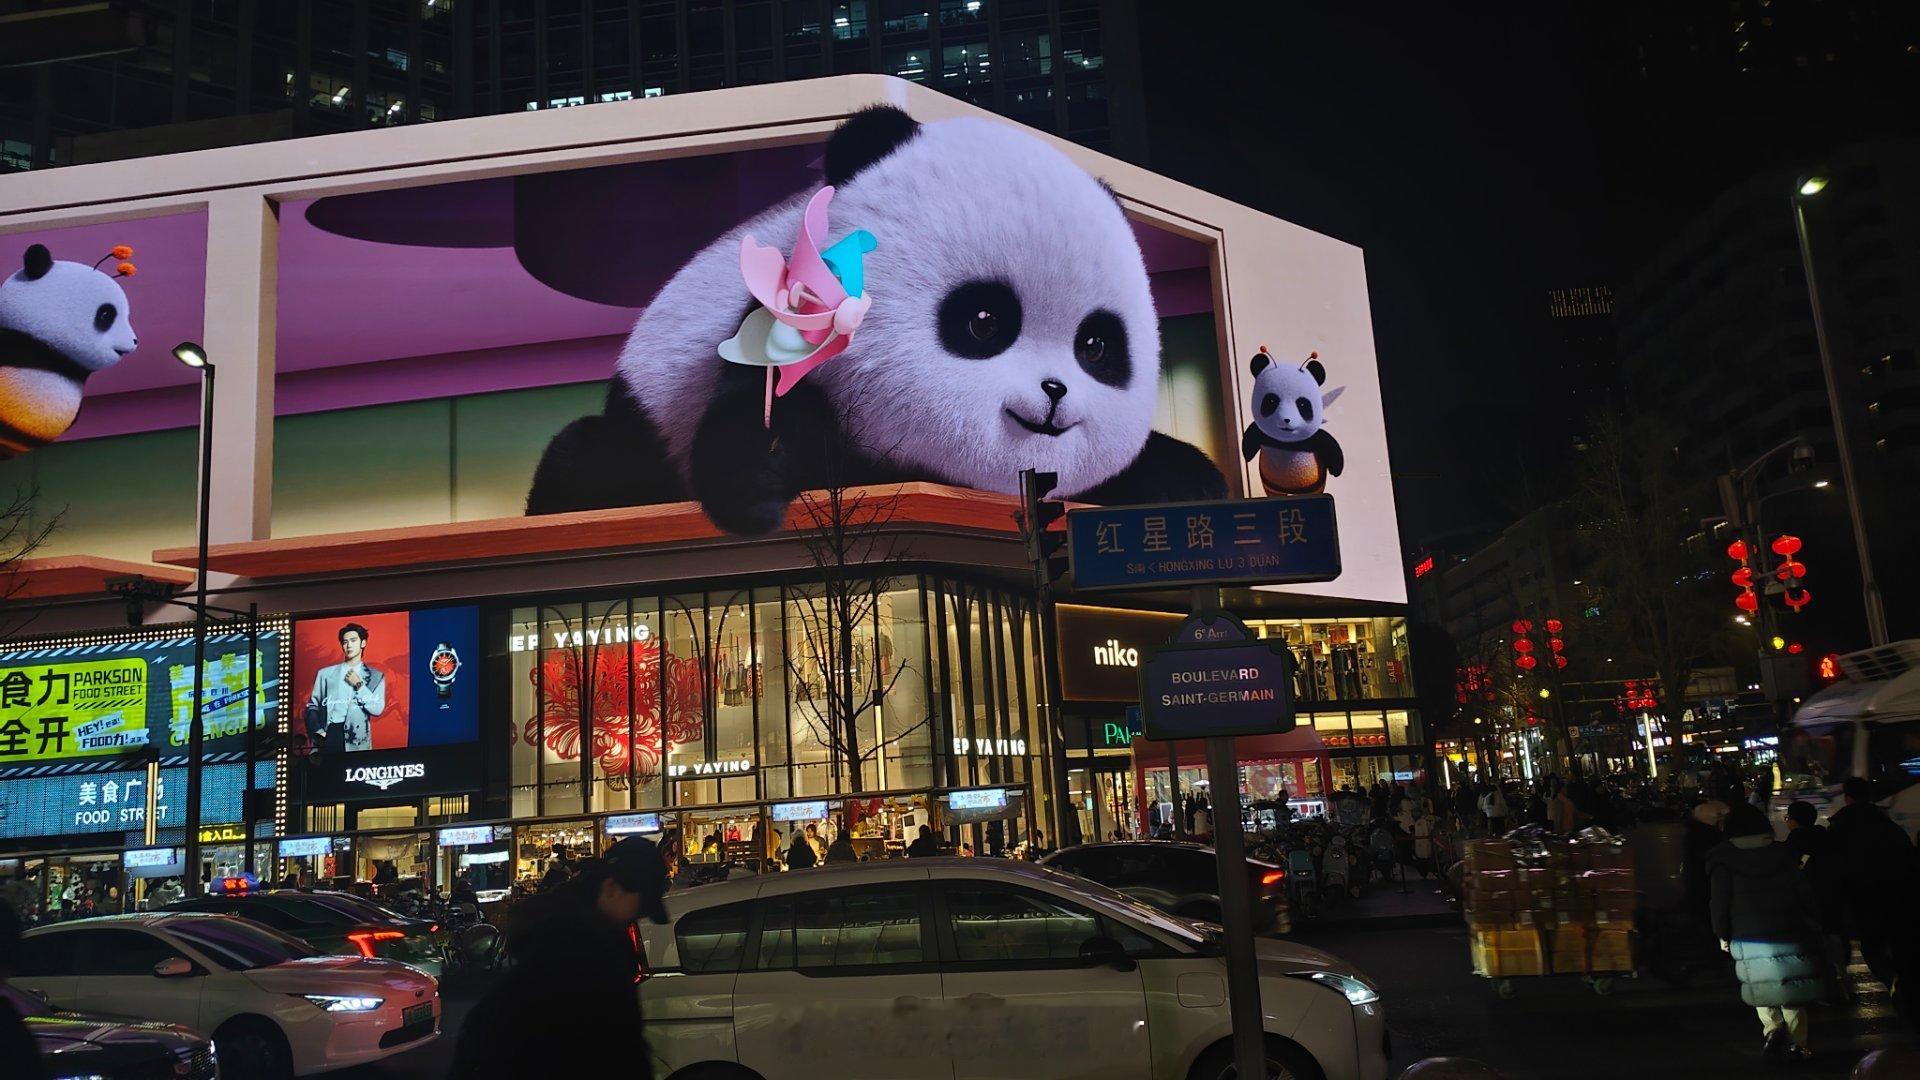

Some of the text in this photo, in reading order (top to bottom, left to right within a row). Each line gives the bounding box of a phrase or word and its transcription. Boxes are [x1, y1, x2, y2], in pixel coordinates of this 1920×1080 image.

[1095, 509, 1308, 553] 红星路三段
[1159, 559, 1214, 573] HONGXING
[1218, 558, 1233, 570] LU
[1238, 556, 1245, 569] 3
[1250, 554, 1280, 568] DUAN
[510, 624, 650, 651] EP YAYING
[1094, 639, 1138, 667] niko
[73, 667, 143, 687] PARKSON
[1172, 668, 1259, 684] BOULEVARD
[0, 668, 70, 709] 食力
[73, 684, 142, 700] FOOD STREET
[1162, 688, 1275, 706] SAINT-GERMAIN
[0, 716, 70, 755] 全开
[77, 720, 105, 738] HEY!
[953, 737, 1026, 756] EP YAYING
[345, 763, 425, 782] LONGINES
[668, 760, 750, 777] EP YAYING
[75, 805, 168, 826] FOOD STRT
